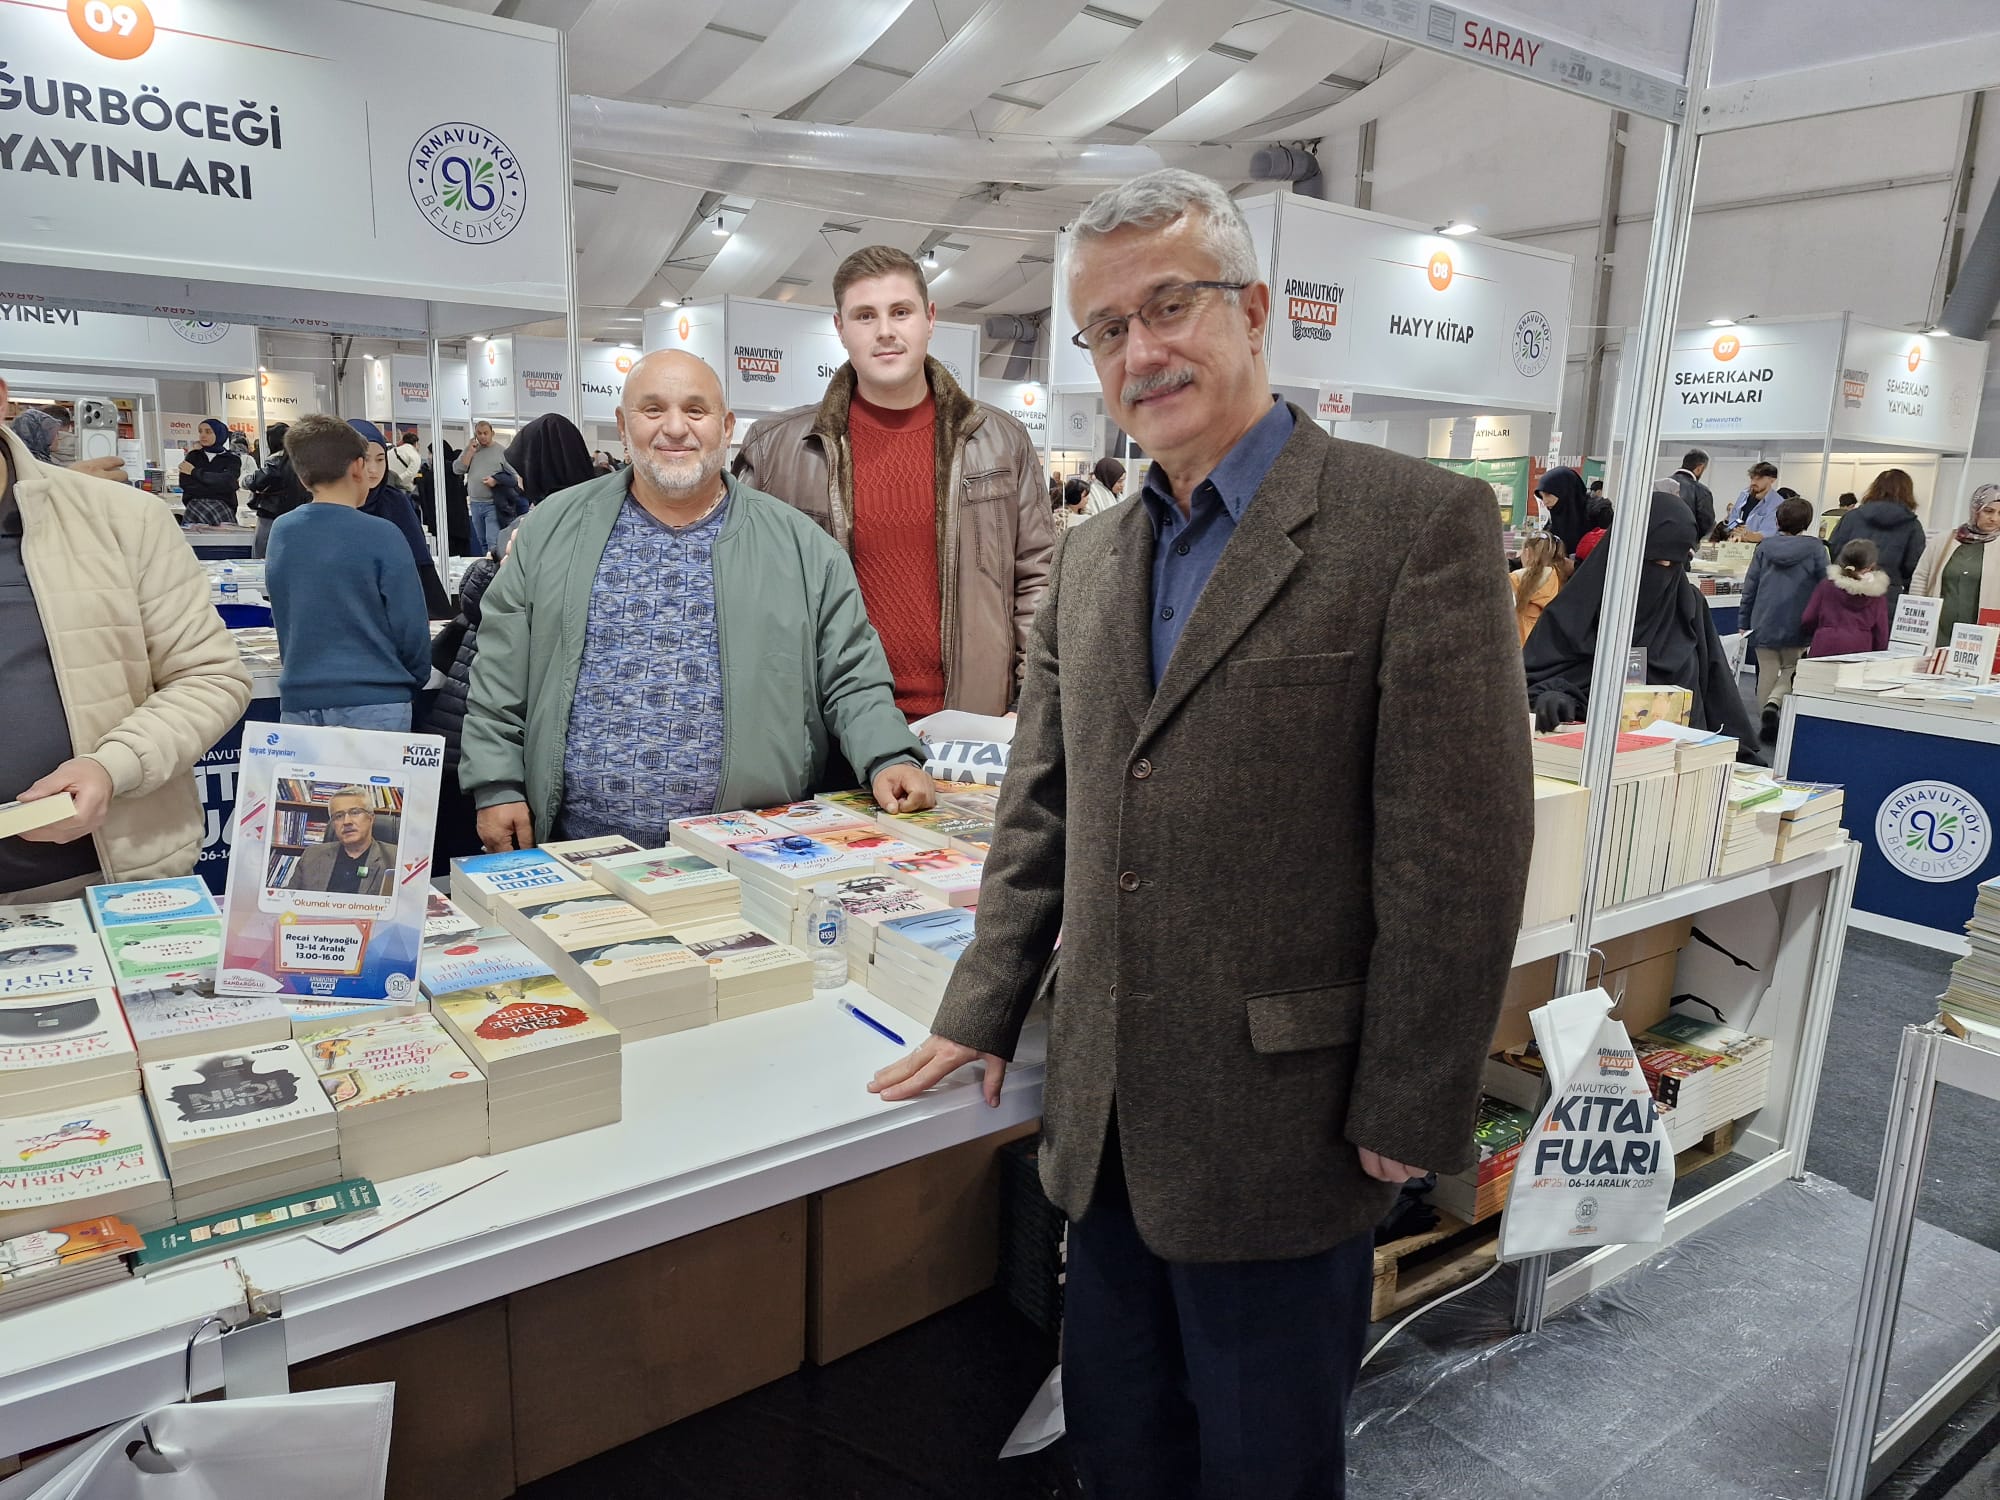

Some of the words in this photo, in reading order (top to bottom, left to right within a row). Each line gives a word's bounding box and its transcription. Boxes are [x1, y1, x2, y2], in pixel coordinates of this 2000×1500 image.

[84, 2, 137, 38] 09
[1464, 21, 1541, 67] SARAY
[416, 128, 520, 184] ARNAVUTKÖY
[1432, 261, 1449, 279] 08
[1284, 278, 1345, 304] ARNAVUTKÖY
[1291, 302, 1336, 324] HAYAT
[1389, 314, 1433, 340] HAYY
[1436, 317, 1475, 345] KİTAP
[733, 345, 784, 361] ARNAVUTKÖY
[738, 358, 779, 374] HAYAT
[1674, 368, 1774, 386] SEMERKAND
[581, 382, 613, 397] TİMAŞ
[1681, 389, 1763, 405] YAYINLARI
[1886, 378, 1930, 398] SEMERKAND
[239, 394, 257, 402] HAR
[1890, 788, 1981, 835] ARNAVUTKÖY
[285, 933, 311, 944] Recai
[313, 935, 359, 948] Yahyaoğlu
[295, 942, 317, 951] 13-14
[319, 944, 346, 953] Aralık
[295, 951, 345, 962] 13.00-16.00
[1566, 1083, 1627, 1096] NAVUTKÖY
[1534, 1139, 1661, 1176] FUARI
[1568, 1178, 1596, 1188] 06-14
[1596, 1179, 1632, 1188] ARALIK
